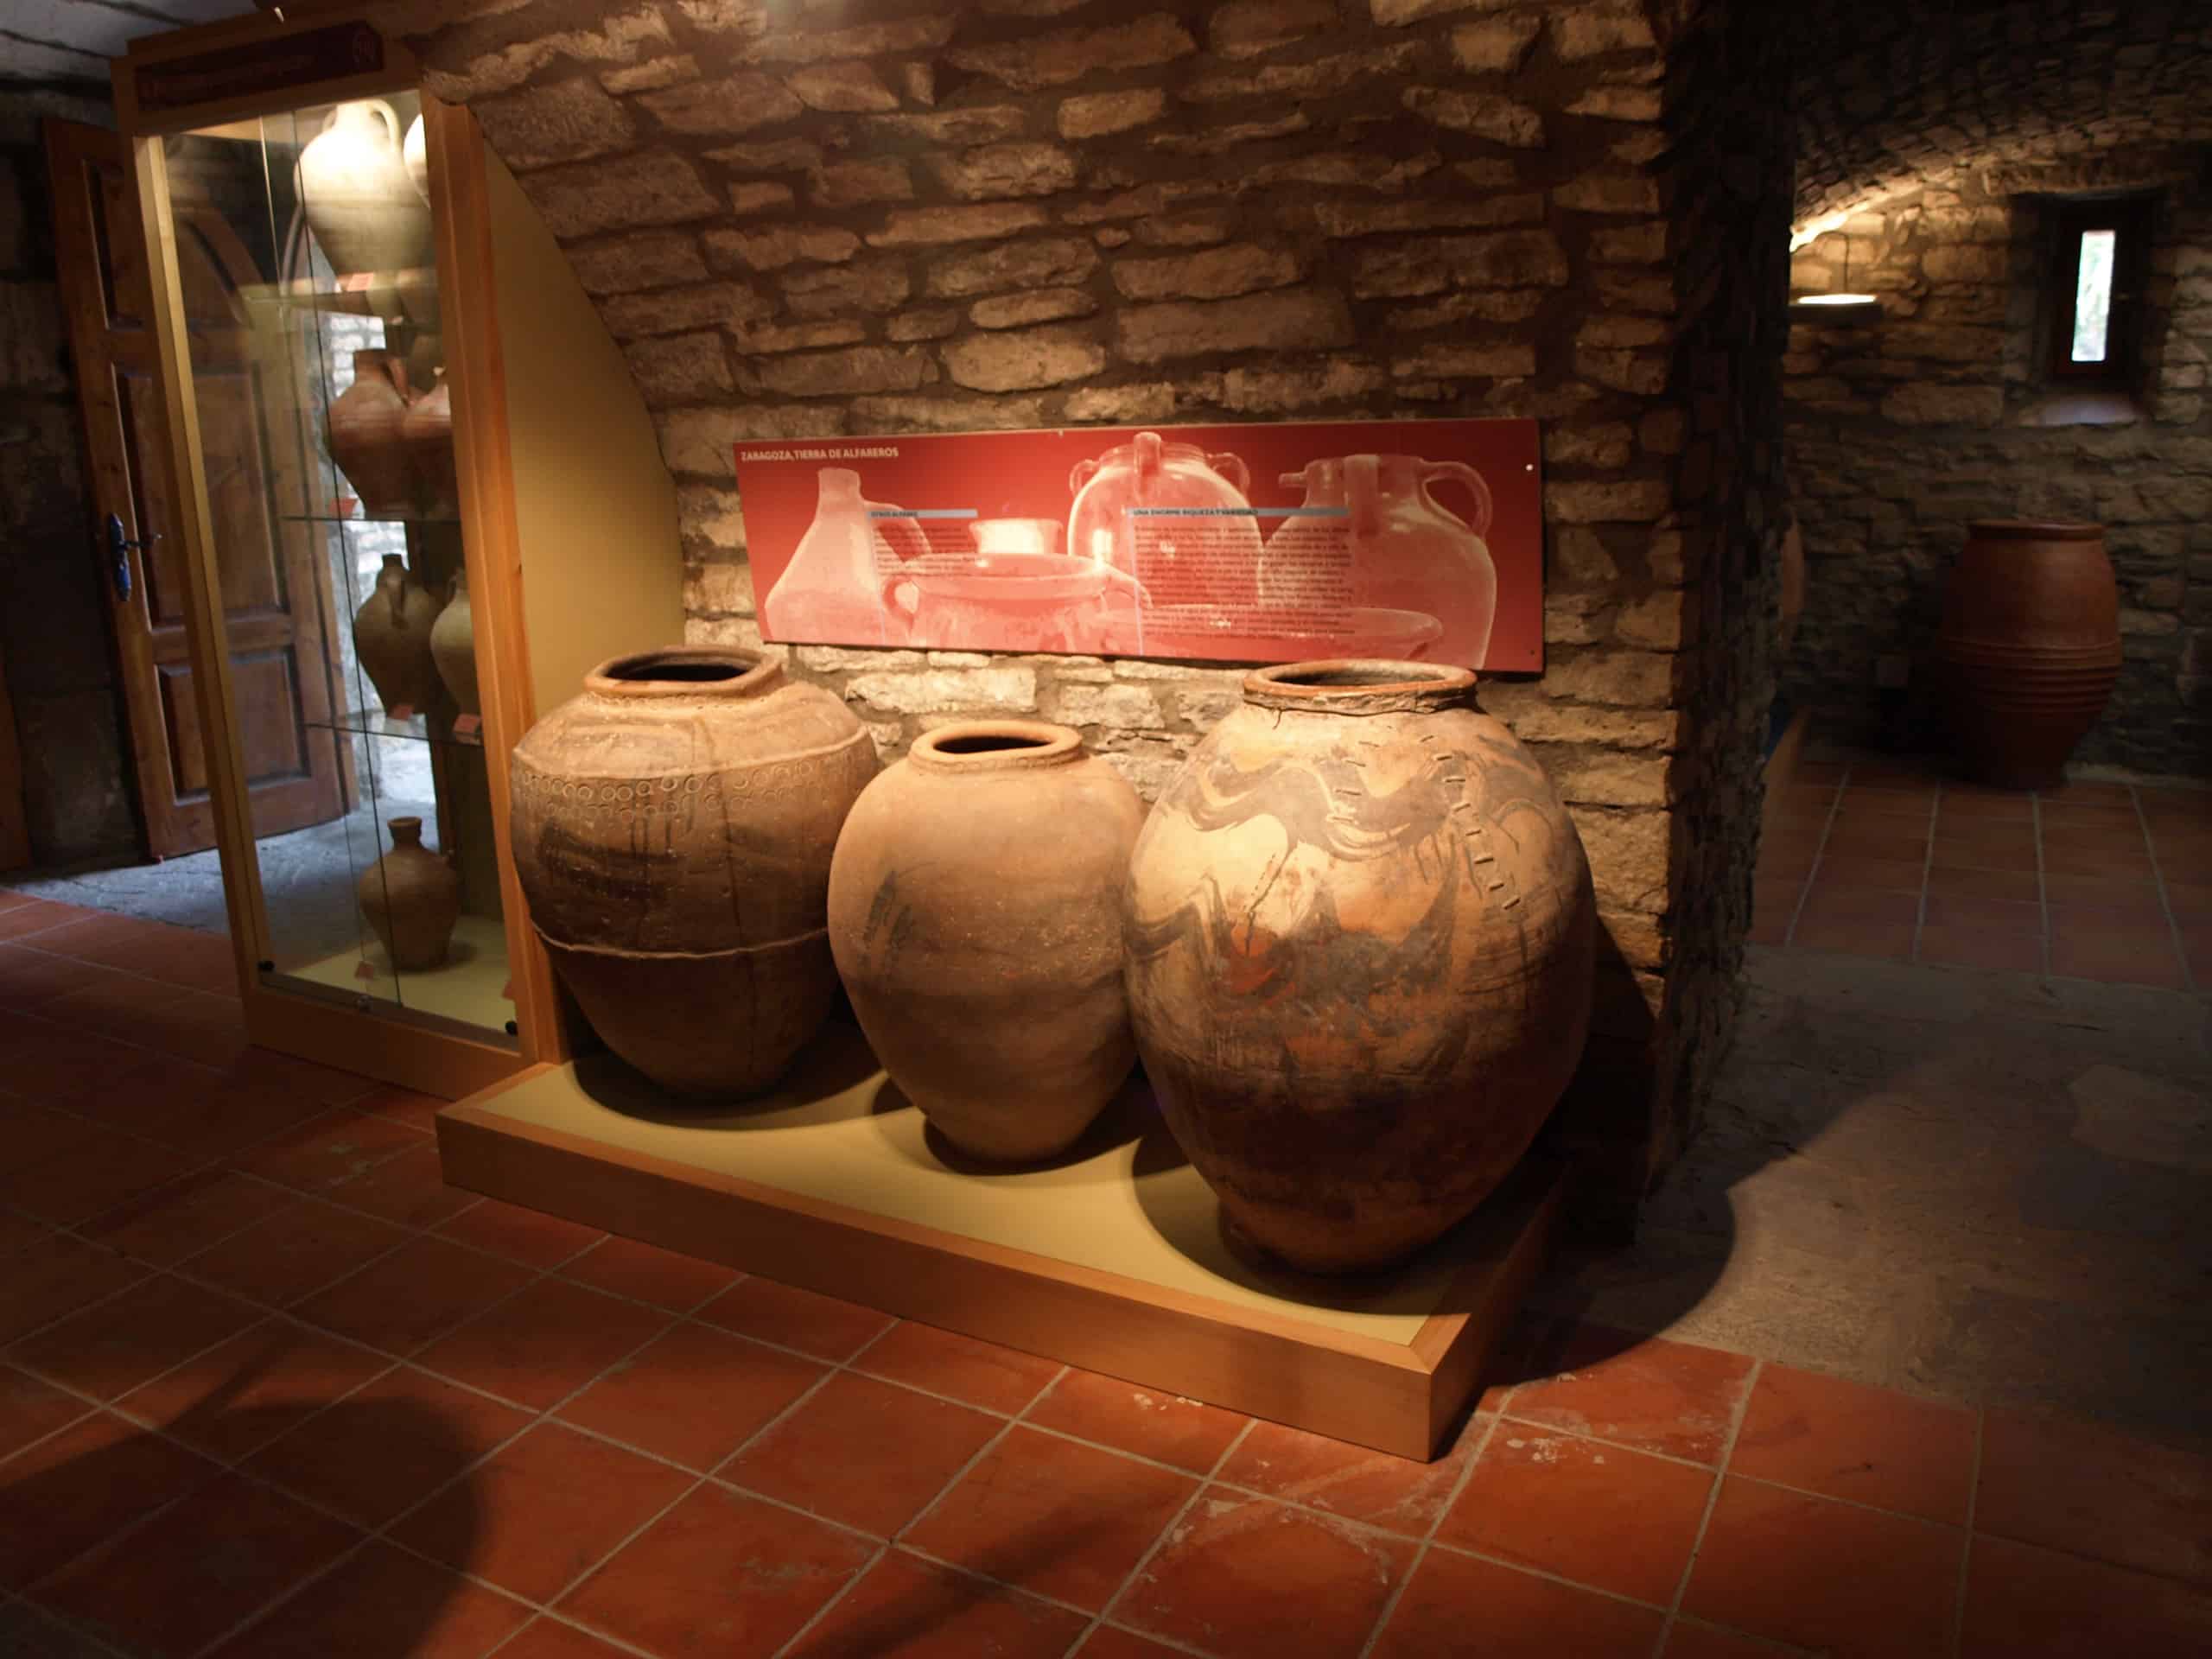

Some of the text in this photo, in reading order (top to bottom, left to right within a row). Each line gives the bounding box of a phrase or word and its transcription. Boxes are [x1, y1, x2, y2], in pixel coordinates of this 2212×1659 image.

[794, 449, 828, 461] TIERRA
[829, 448, 842, 460] DE
[843, 447, 899, 459] ALFAREROS
